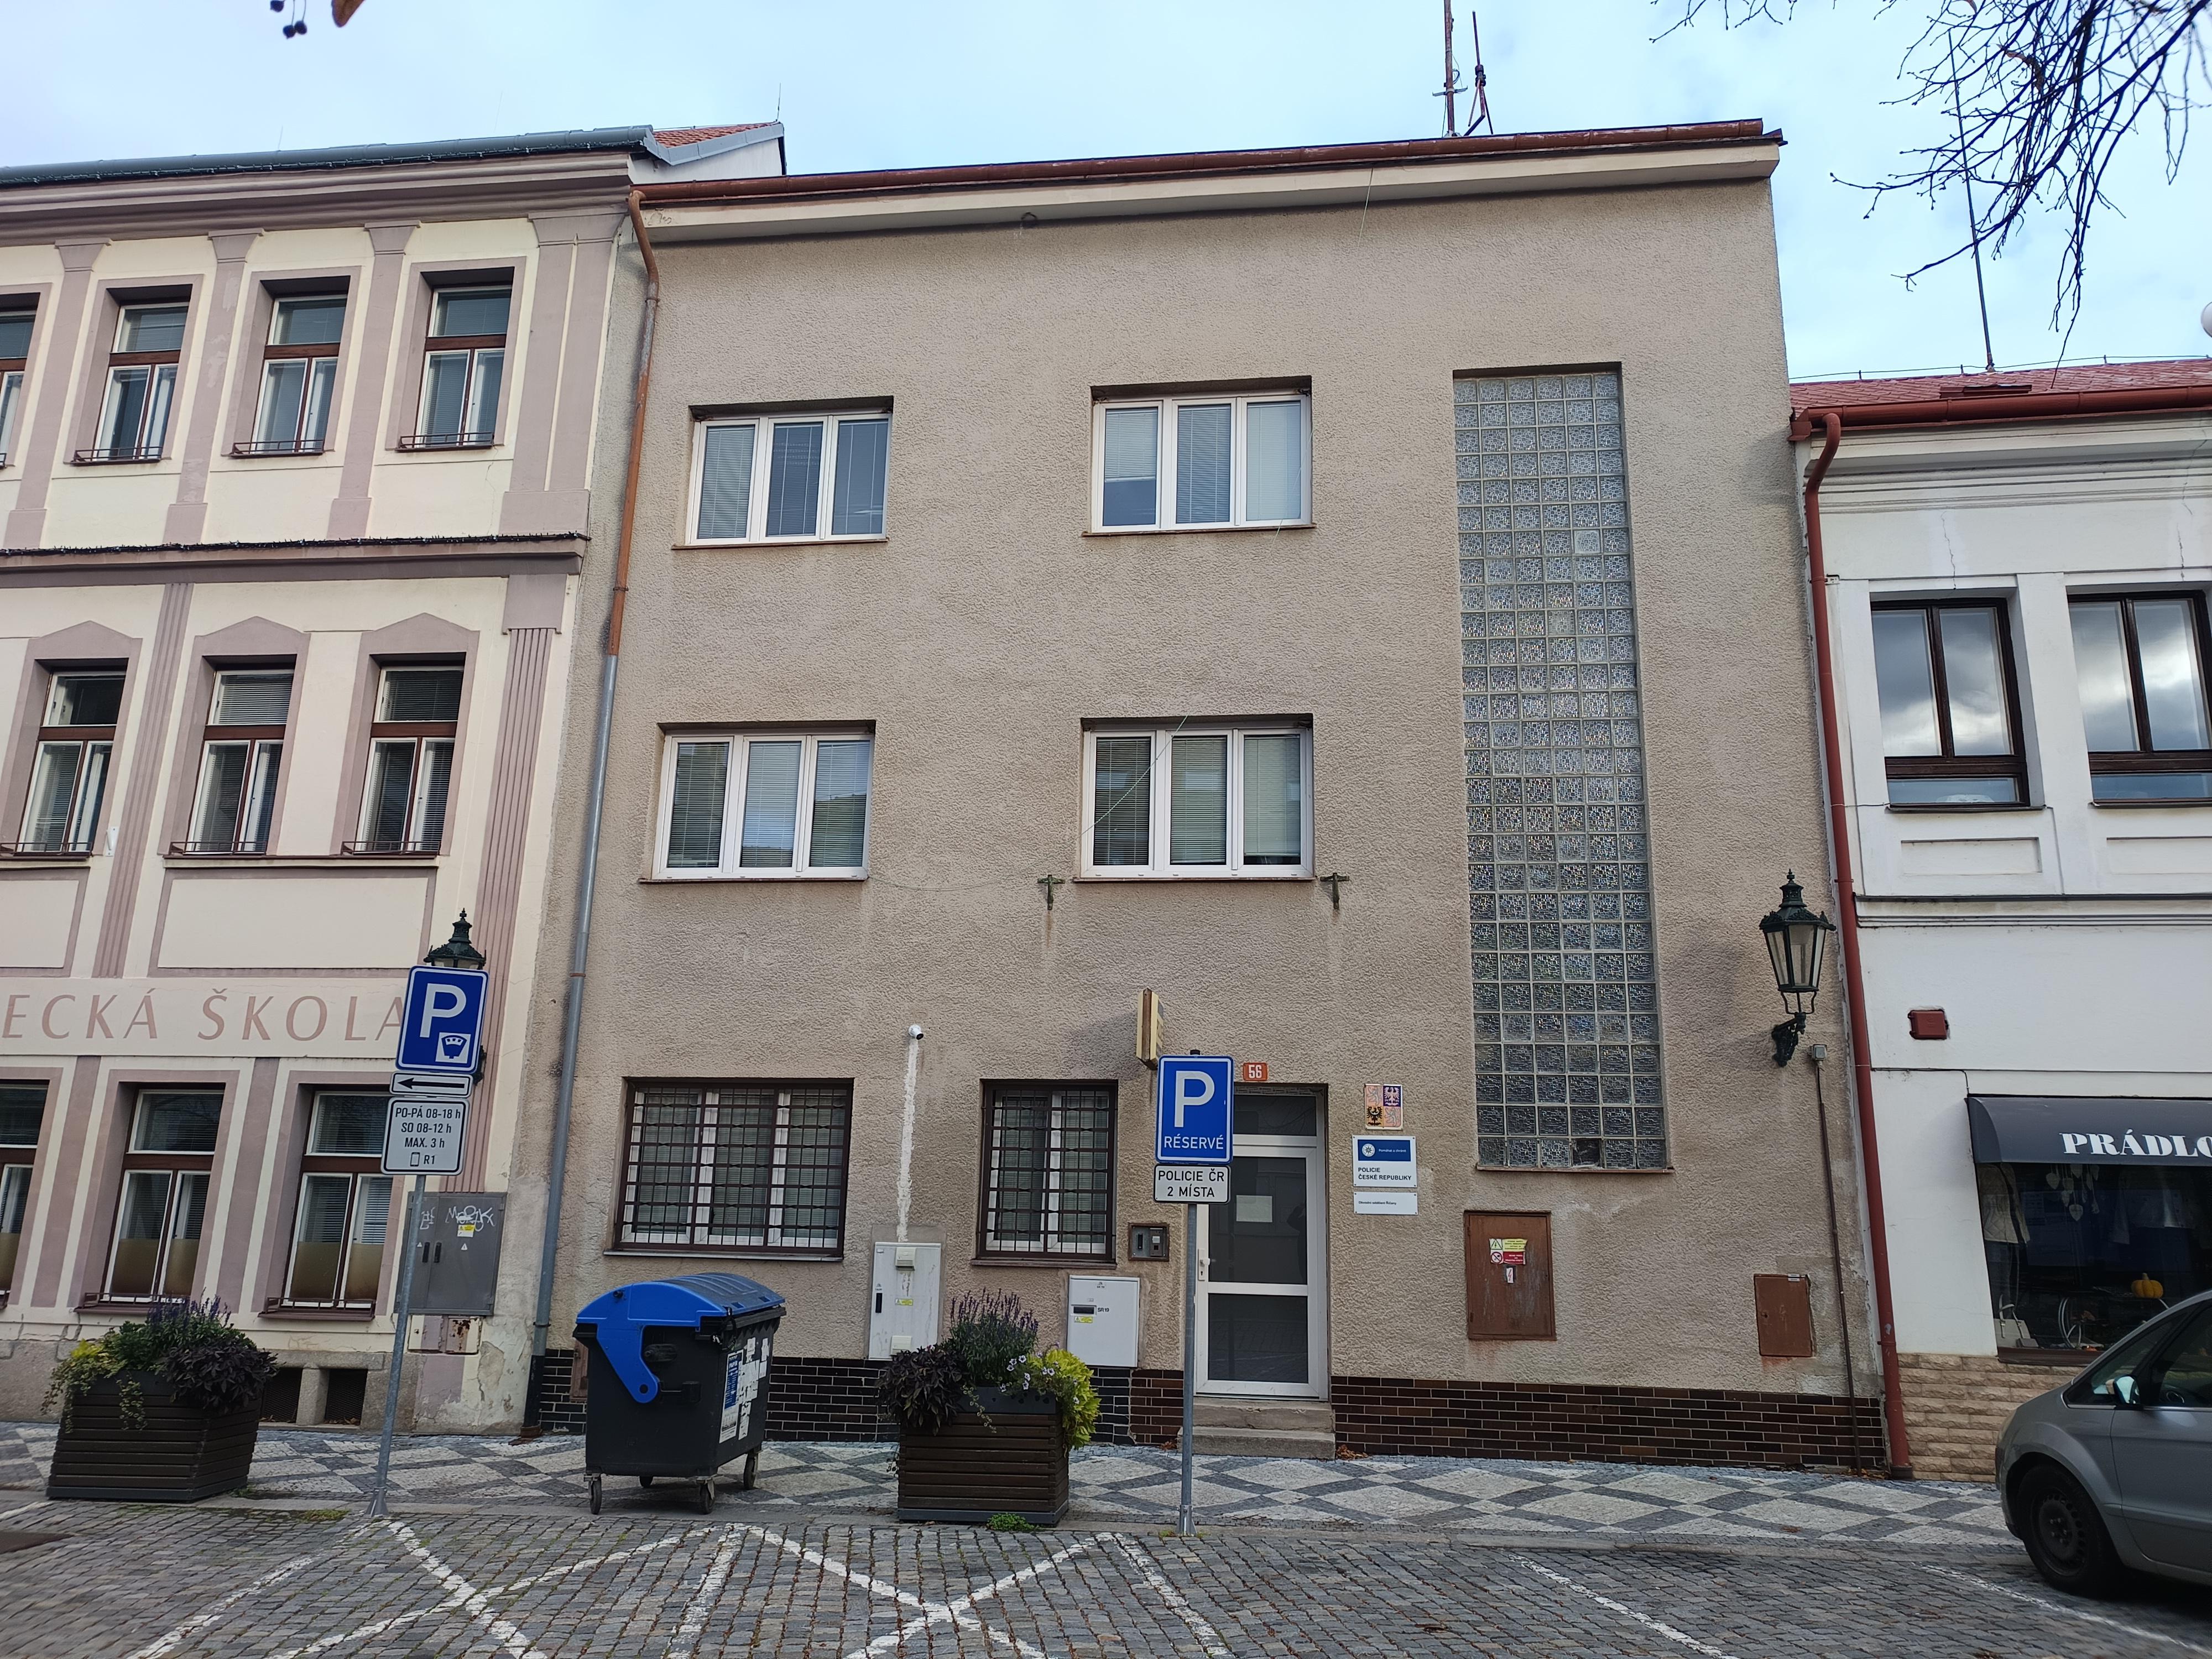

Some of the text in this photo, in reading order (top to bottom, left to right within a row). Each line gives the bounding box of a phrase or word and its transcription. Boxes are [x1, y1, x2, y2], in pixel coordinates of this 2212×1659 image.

[2, 988, 403, 1041] ECKÁ ŠKOLA
[420, 983, 467, 1038] P
[1248, 1065, 1262, 1079] 56
[1174, 1070, 1215, 1128] P
[395, 1105, 461, 1119] PO-PÁ 08-18 h
[401, 1122, 451, 1133] SO 08-12 h
[404, 1138, 445, 1148] MAX. 3 h
[1164, 1134, 1224, 1150] RÉSERVÉ
[424, 1155, 435, 1164] R1
[1158, 1168, 1224, 1182] POLICIE ČR
[1167, 1183, 1215, 1197] 2 MÍSTA
